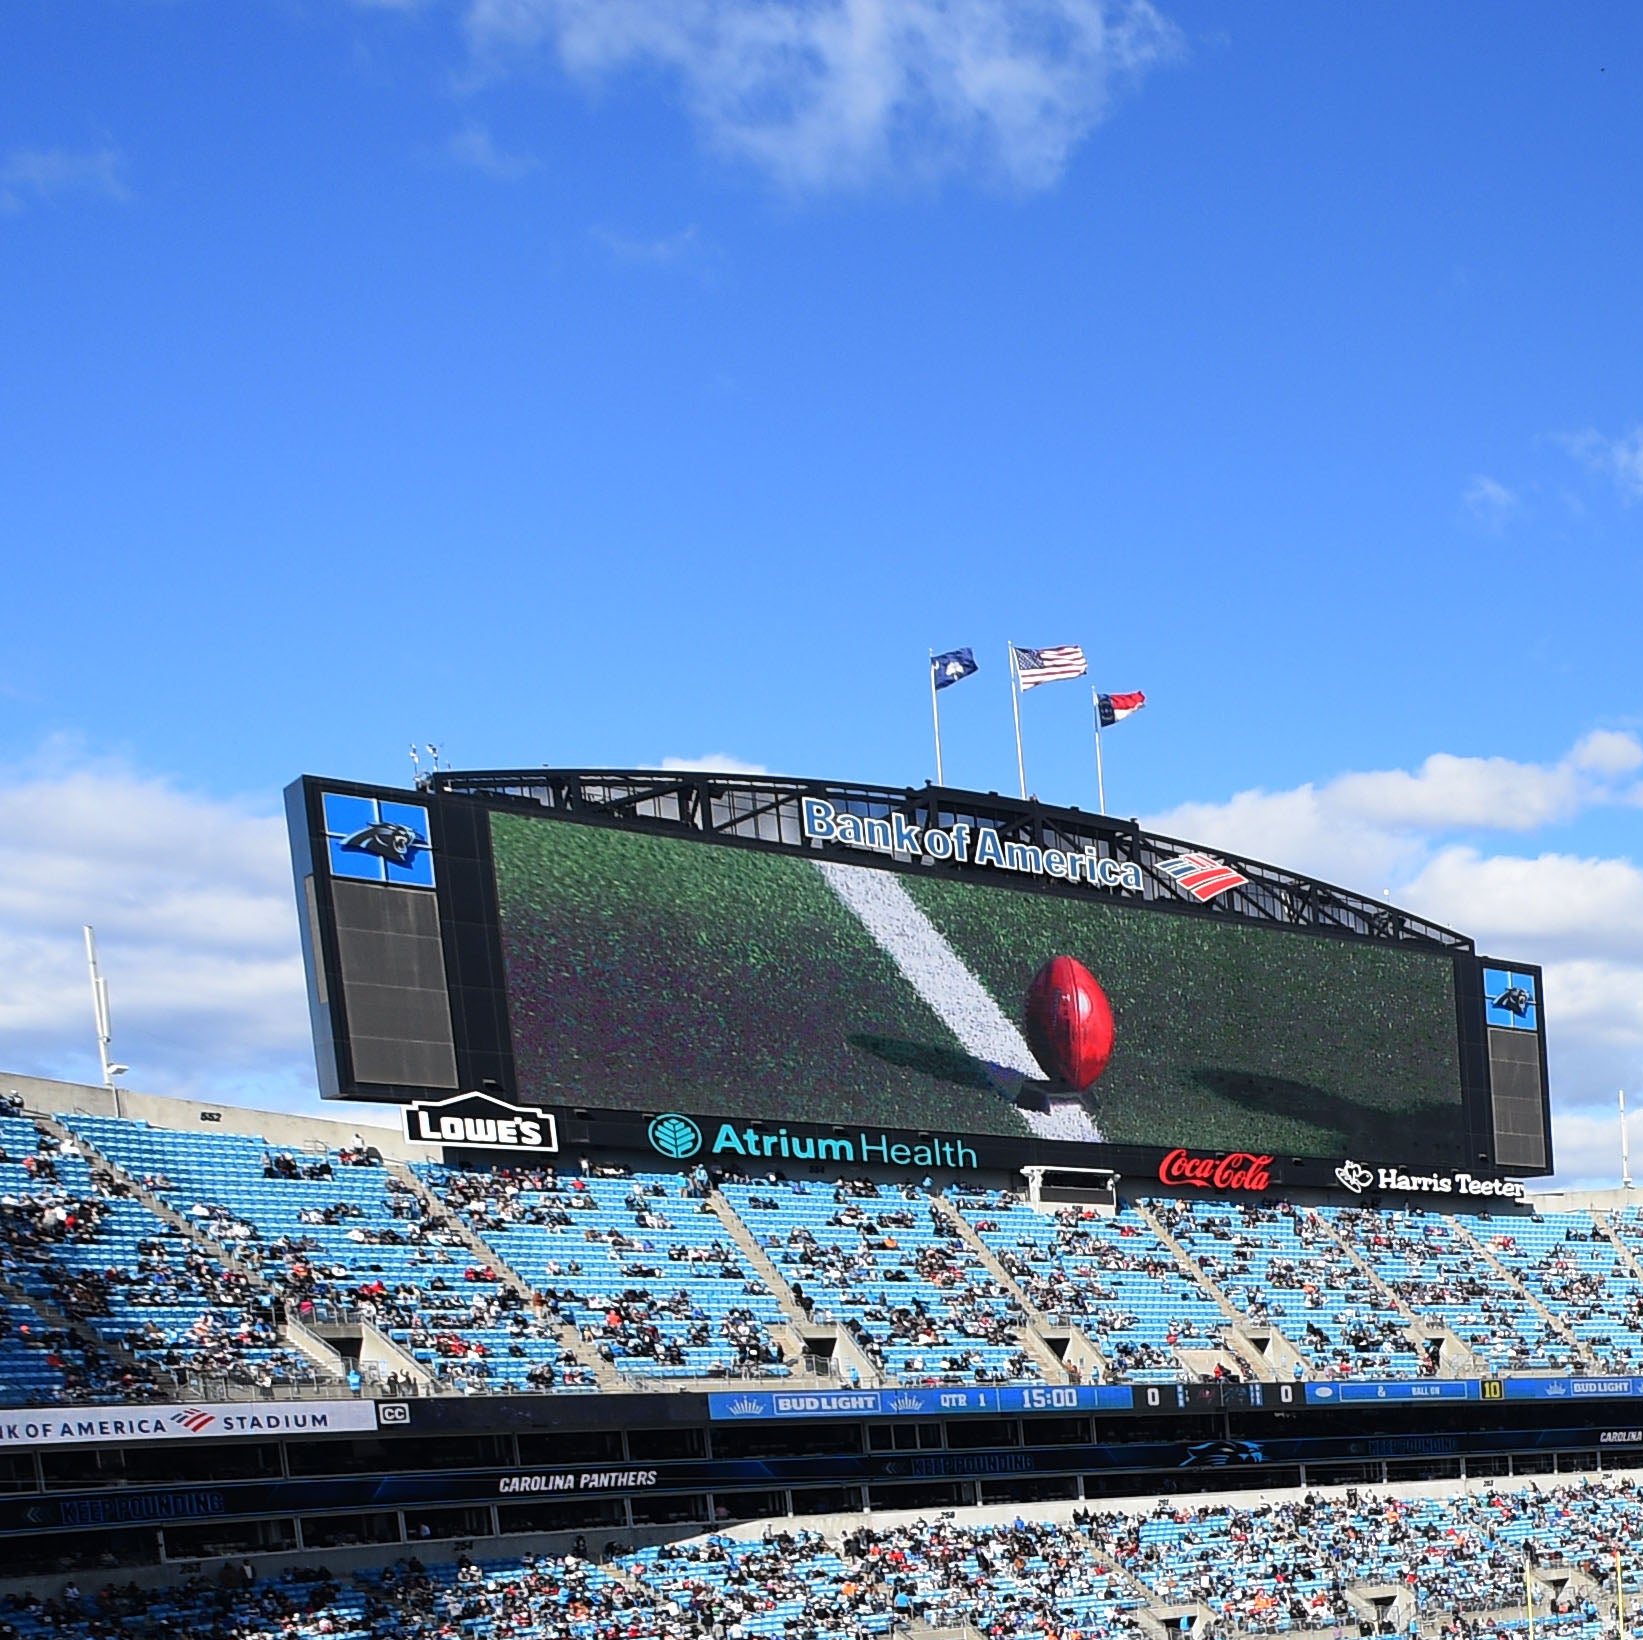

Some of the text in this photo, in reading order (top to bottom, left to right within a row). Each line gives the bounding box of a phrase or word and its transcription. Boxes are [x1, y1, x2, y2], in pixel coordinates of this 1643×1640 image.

[801, 798, 1145, 891] Bank of America
[418, 1110, 542, 1145] LOWE'S
[712, 1124, 978, 1168] Atrium Health
[1158, 1148, 1275, 1191] Coca-Cola
[1377, 1168, 1526, 1199] Harris Teeter
[1147, 1387, 1160, 1407] 0
[1280, 1385, 1292, 1403] 0
[1484, 1382, 1500, 1399] 10
[1573, 1380, 1630, 1393] BUD LIGHT
[779, 1394, 876, 1411] BUD LIGHT
[940, 1393, 987, 1408] QTR 1
[1022, 1387, 1078, 1409] 15:00
[384, 1406, 405, 1420] CC
[26, 1413, 328, 1439] OF AMERICA STADIUM
[1600, 1430, 1643, 1443] CAROLINA
[500, 1470, 657, 1494] CAROLINA PANTHERS
